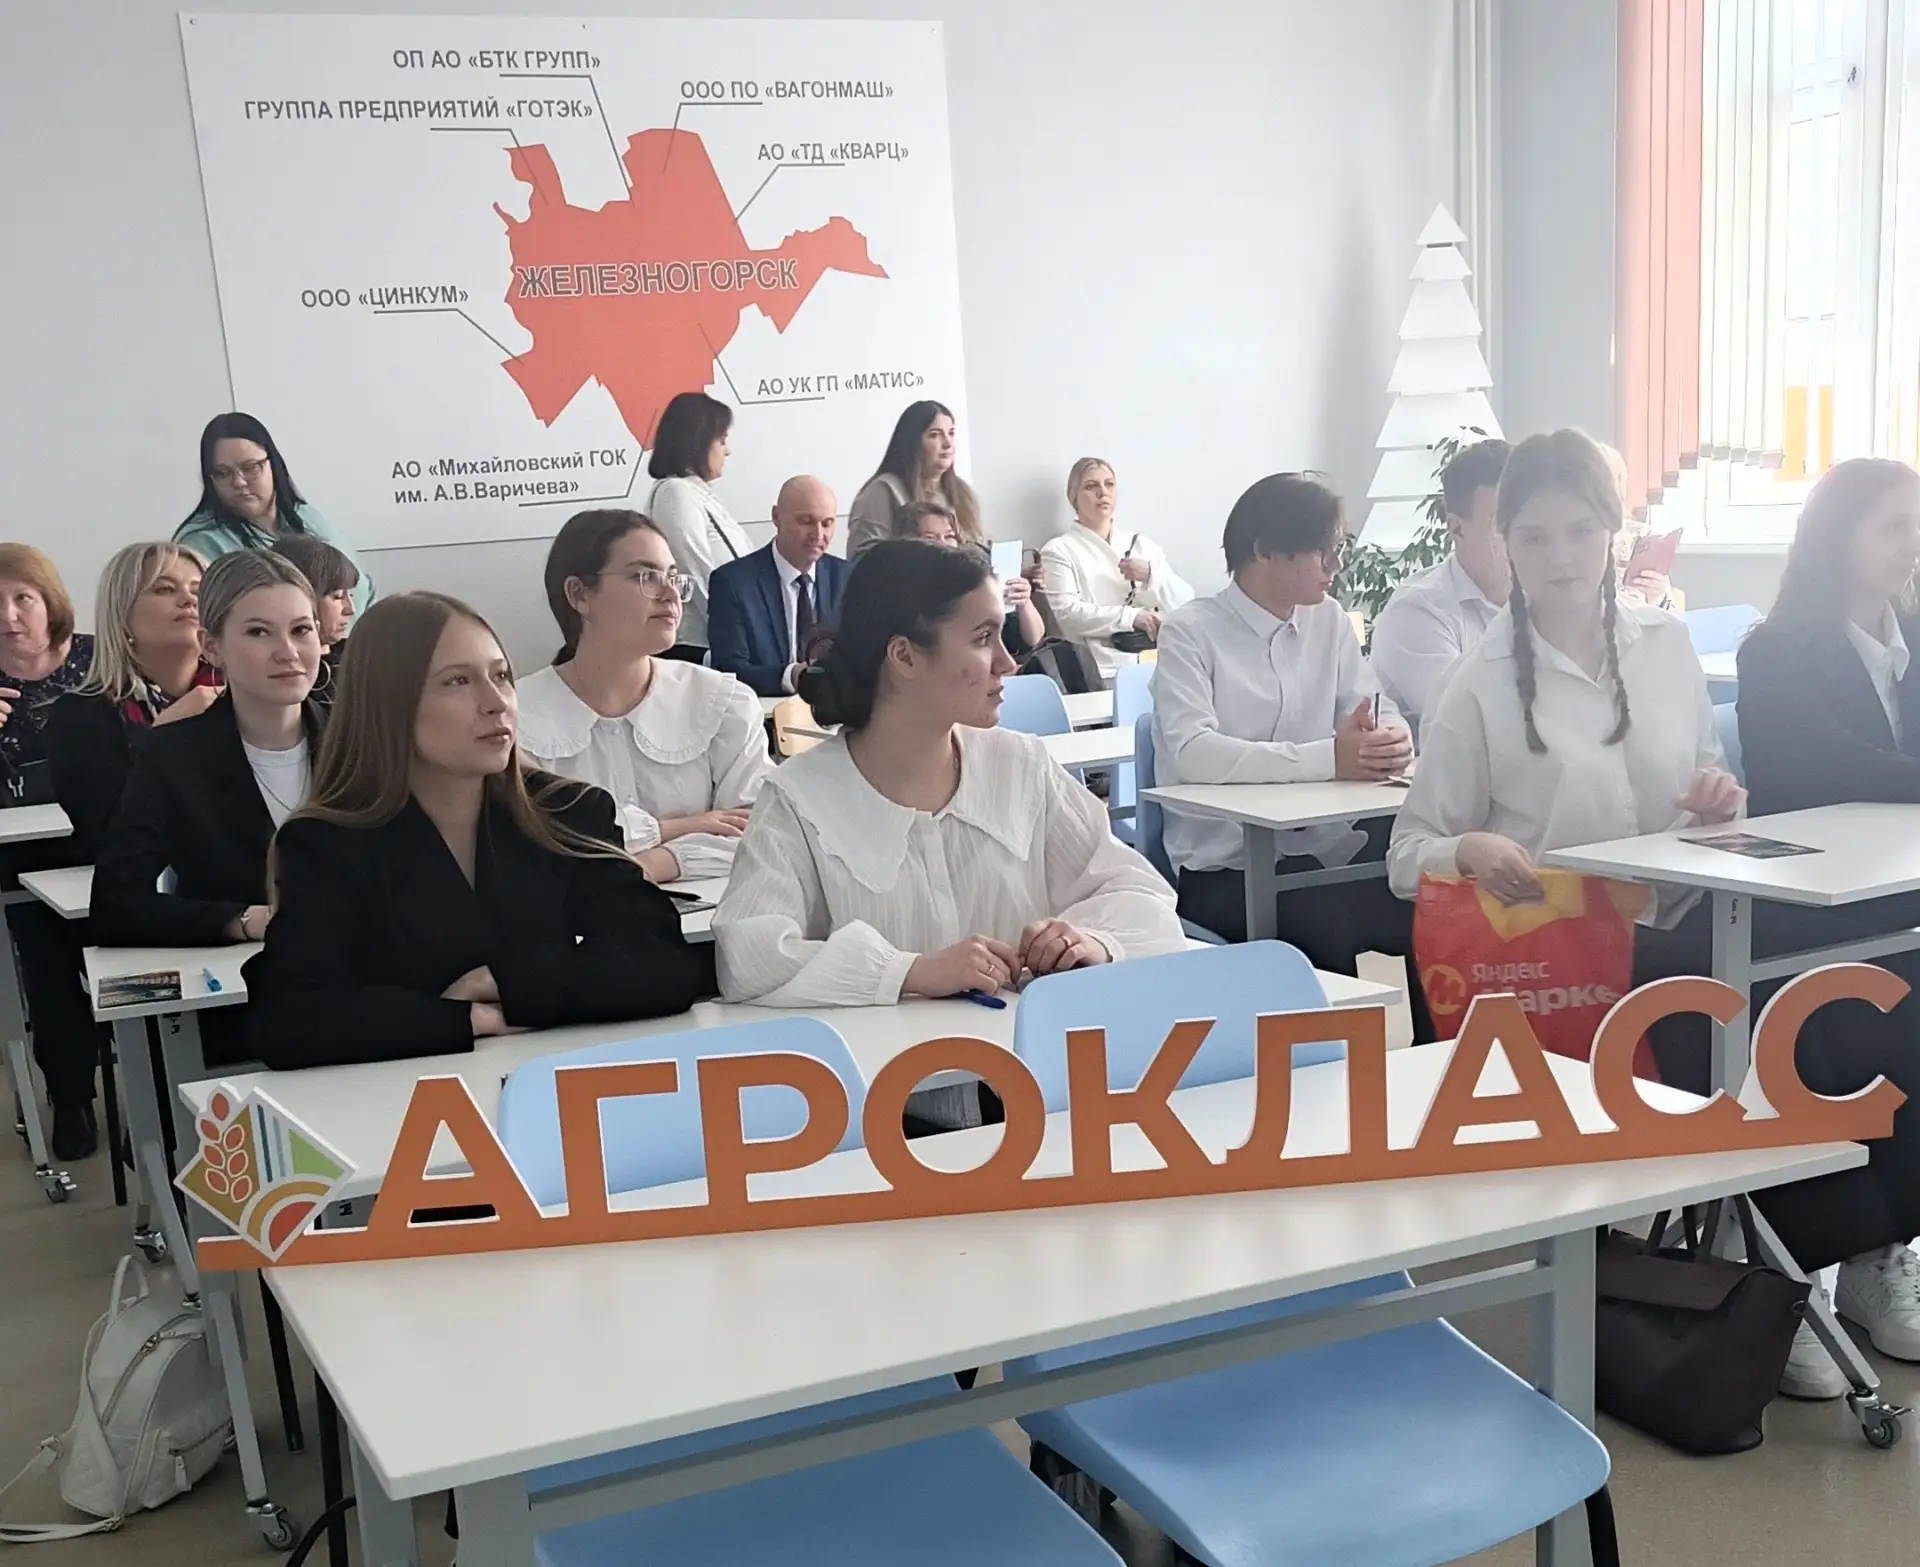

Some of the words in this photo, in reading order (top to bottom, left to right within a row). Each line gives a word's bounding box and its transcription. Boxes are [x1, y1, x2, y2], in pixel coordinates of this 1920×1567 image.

[393, 50, 424, 69] ОП
[431, 50, 461, 69] АО
[469, 49, 519, 69] «БТК
[525, 50, 601, 69] ГРУПП»
[680, 81, 725, 98] ООО
[732, 81, 758, 98] ПО
[765, 80, 894, 98] «ВАГОНМАШ»
[245, 101, 333, 120] ГРУППА
[339, 96, 499, 121] ПРЕДПРИЯТИЙ
[506, 100, 593, 118] «ГОТЭК»
[757, 144, 785, 161] АО
[791, 144, 825, 163] «ТД
[830, 142, 909, 161] «КВАРЦ»
[517, 258, 799, 299] ЖЕЛЕЗНОГОРСК
[301, 289, 350, 307] ООО
[358, 286, 469, 308] «ЦИНКУМ»
[757, 378, 784, 395] АО
[789, 377, 812, 393] УК
[817, 375, 839, 392] ГП
[845, 371, 924, 390] «МАТИС»
[391, 460, 422, 479] АО
[428, 452, 584, 477] «Михайловский
[589, 448, 627, 467] ГОК
[395, 489, 428, 504] им.
[434, 480, 579, 502] А.В.Варичева»
[1471, 962, 1550, 983] Яндекс
[366, 963, 1910, 1236] АГРОКЛАСС
